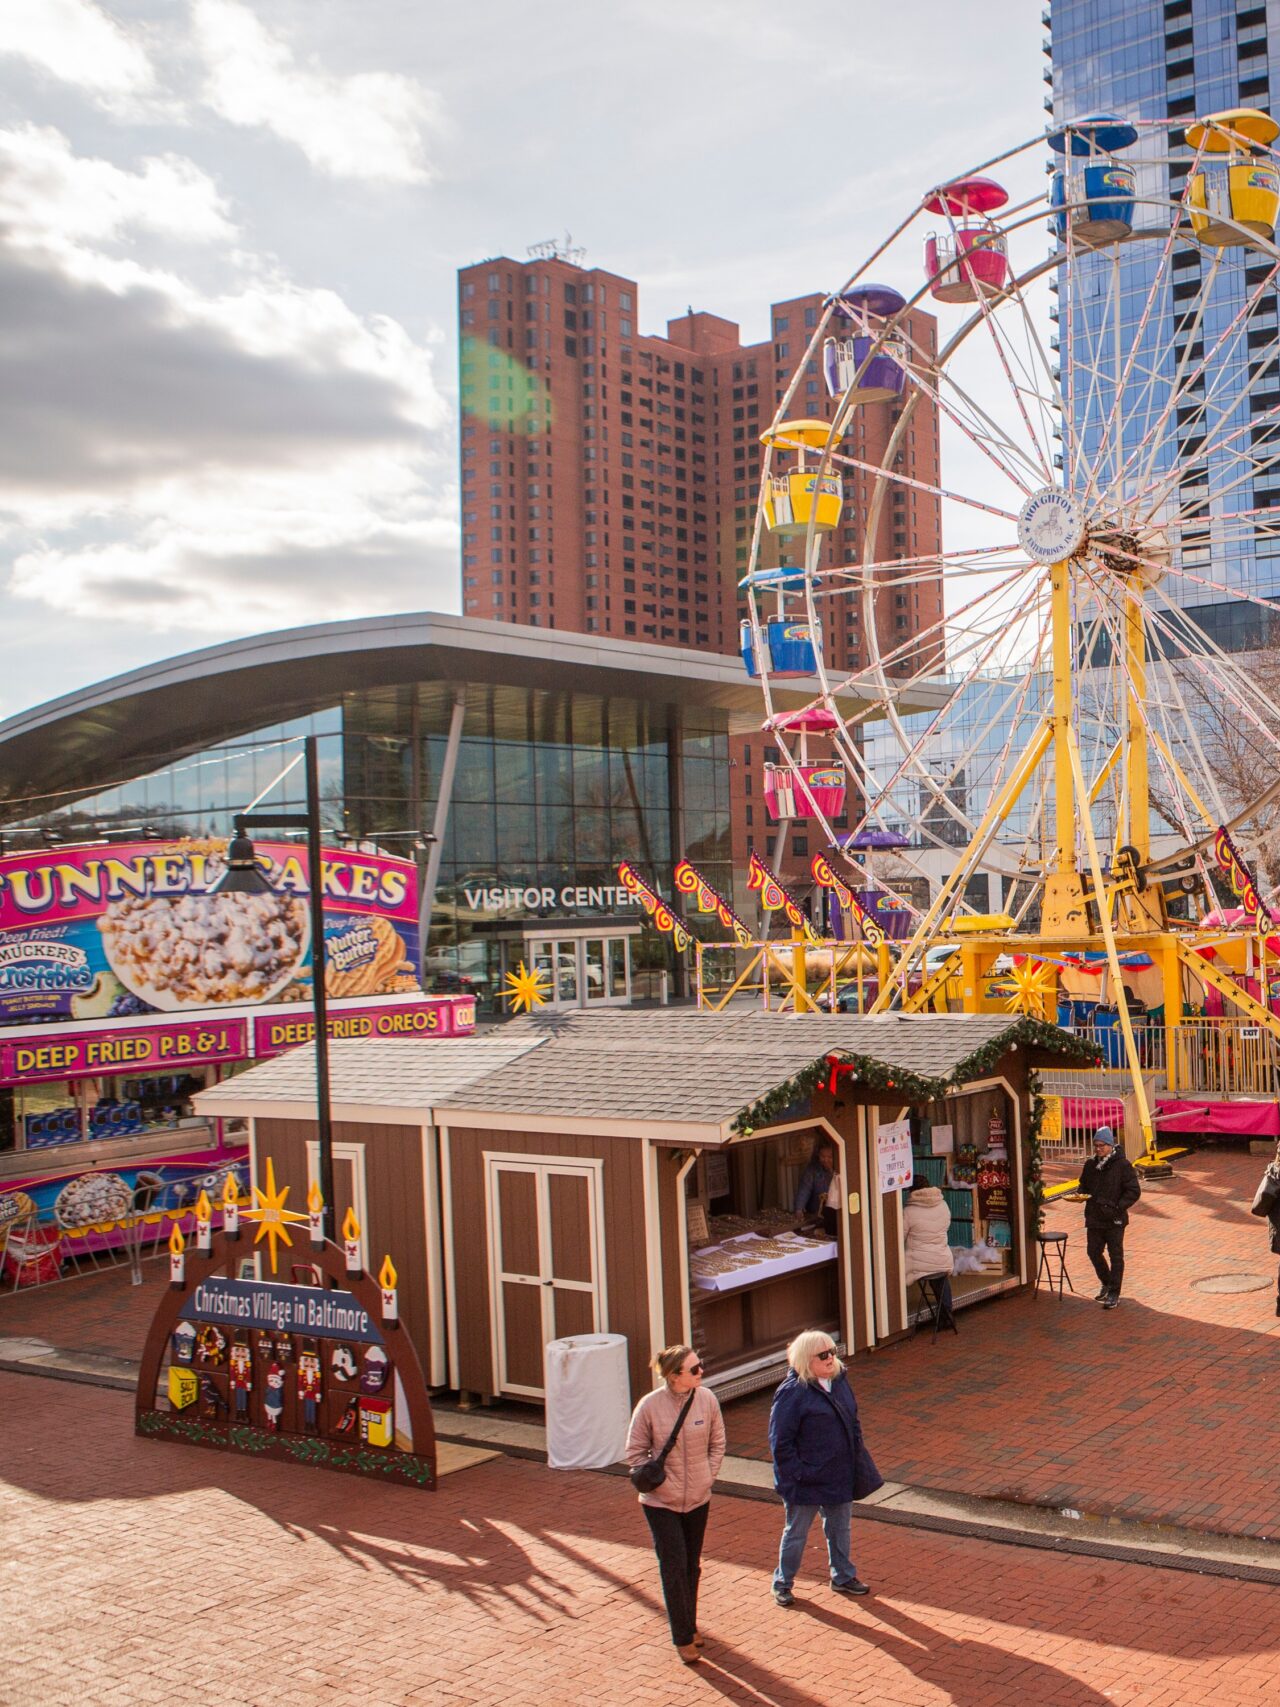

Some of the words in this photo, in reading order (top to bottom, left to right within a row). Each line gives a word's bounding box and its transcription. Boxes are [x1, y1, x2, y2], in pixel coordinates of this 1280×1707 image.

[1025, 495, 1072, 521] HOUGHTON
[254, 856, 407, 908] AKES
[465, 887, 556, 910] VISITOR
[561, 886, 642, 907] CENTER
[29, 926, 68, 940] Fried!
[325, 929, 372, 955] Nutter
[0, 945, 79, 962] MUCKER'S
[334, 940, 378, 971] Butter
[271, 1023, 316, 1045] DEEP
[377, 1011, 438, 1034] OREOS
[16, 1046, 79, 1071] DEEP
[87, 1038, 152, 1064] FRIED
[195, 1285, 251, 1317] Christmas
[253, 1292, 291, 1329] Village
[294, 1296, 306, 1324] in
[308, 1299, 368, 1333] Baltimore
[180, 1381, 196, 1393] SALT
